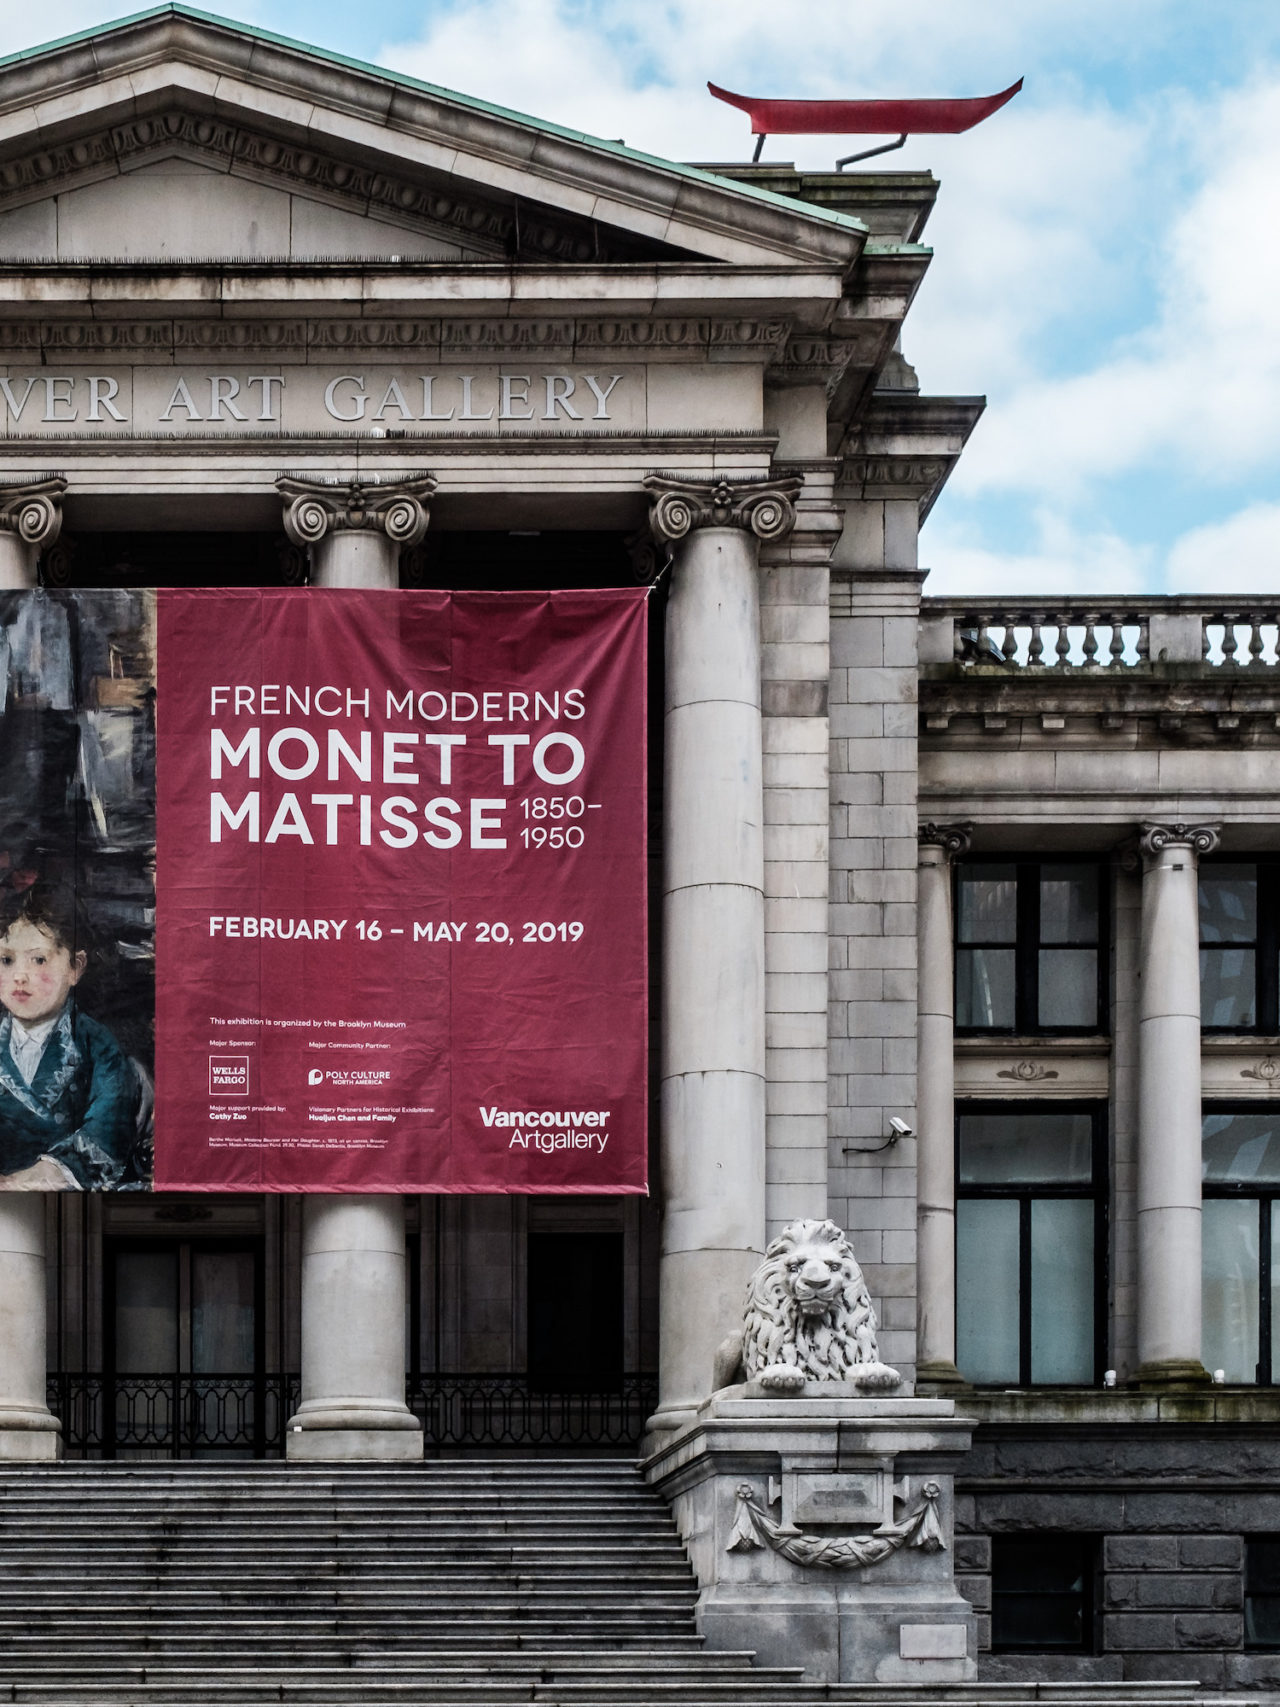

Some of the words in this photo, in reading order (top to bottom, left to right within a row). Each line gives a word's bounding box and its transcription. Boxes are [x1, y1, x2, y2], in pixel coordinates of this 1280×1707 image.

[158, 376, 286, 422] ART
[323, 374, 623, 421] GALLERY
[211, 685, 369, 717] FRENCH
[387, 689, 585, 721] MODERNS
[211, 728, 466, 784] MONET
[488, 732, 585, 785] TO
[210, 792, 506, 849] MATISSE
[520, 826, 584, 848] 1950
[210, 917, 347, 939] FEBRUARY
[356, 920, 382, 941] 16
[414, 922, 467, 941] MAY
[476, 922, 513, 945] 20,
[523, 922, 584, 942] 2019
[210, 1017, 226, 1025] This
[273, 1019, 311, 1028] organized
[313, 1020, 322, 1028] by
[338, 1020, 372, 1029] Brooklyn
[209, 1039, 227, 1047] Major
[328, 1042, 364, 1050] Community
[212, 1067, 246, 1075] WELLS
[326, 1071, 348, 1079] POLY
[214, 1076, 245, 1084] FARGO
[209, 1104, 227, 1112] Major
[228, 1105, 251, 1113] support
[251, 1105, 277, 1113] provided
[209, 1112, 232, 1121] Cathy
[372, 1114, 397, 1123] Family
[480, 1107, 610, 1127] Vancouver
[509, 1129, 608, 1153] Artgallery
